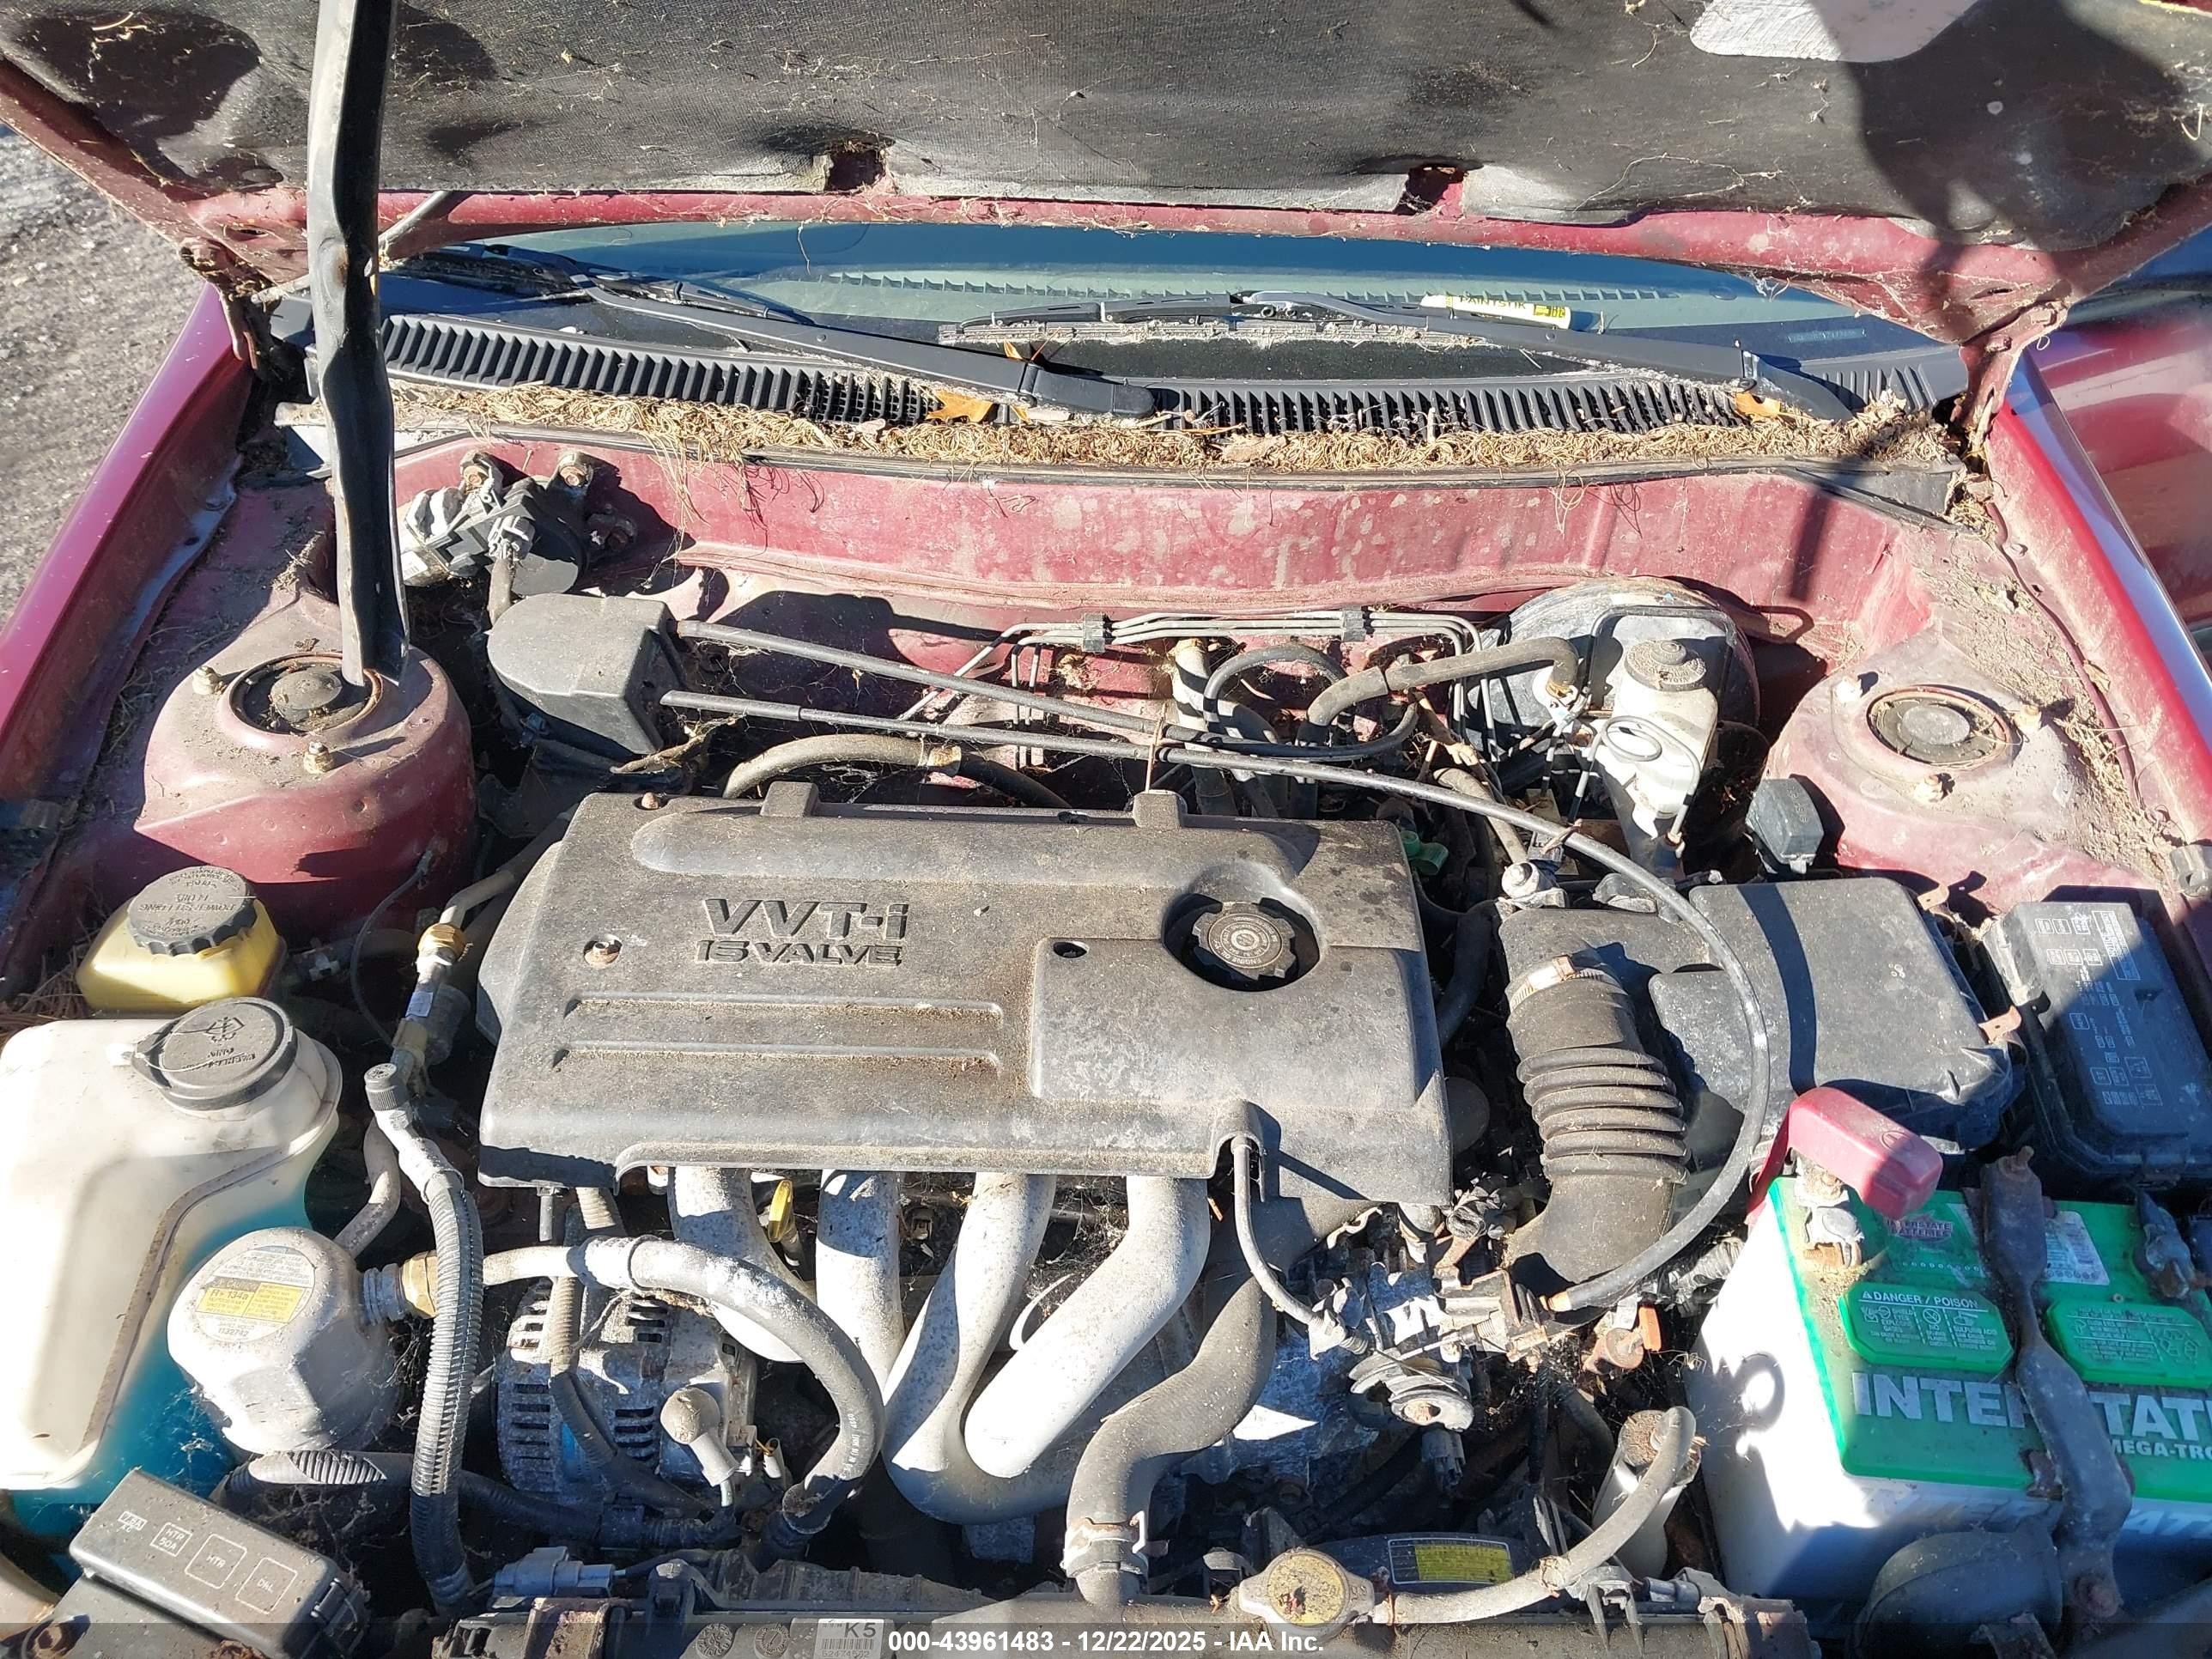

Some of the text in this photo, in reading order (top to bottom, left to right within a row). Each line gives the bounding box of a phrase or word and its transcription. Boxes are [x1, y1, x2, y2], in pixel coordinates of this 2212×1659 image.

[702, 898, 909, 940] VVT-i
[1873, 1291, 1922, 1304] DANGER
[1934, 1297, 1978, 1309] POISON
[165, 1528, 185, 1541] HTR
[159, 1538, 178, 1551] 50A
